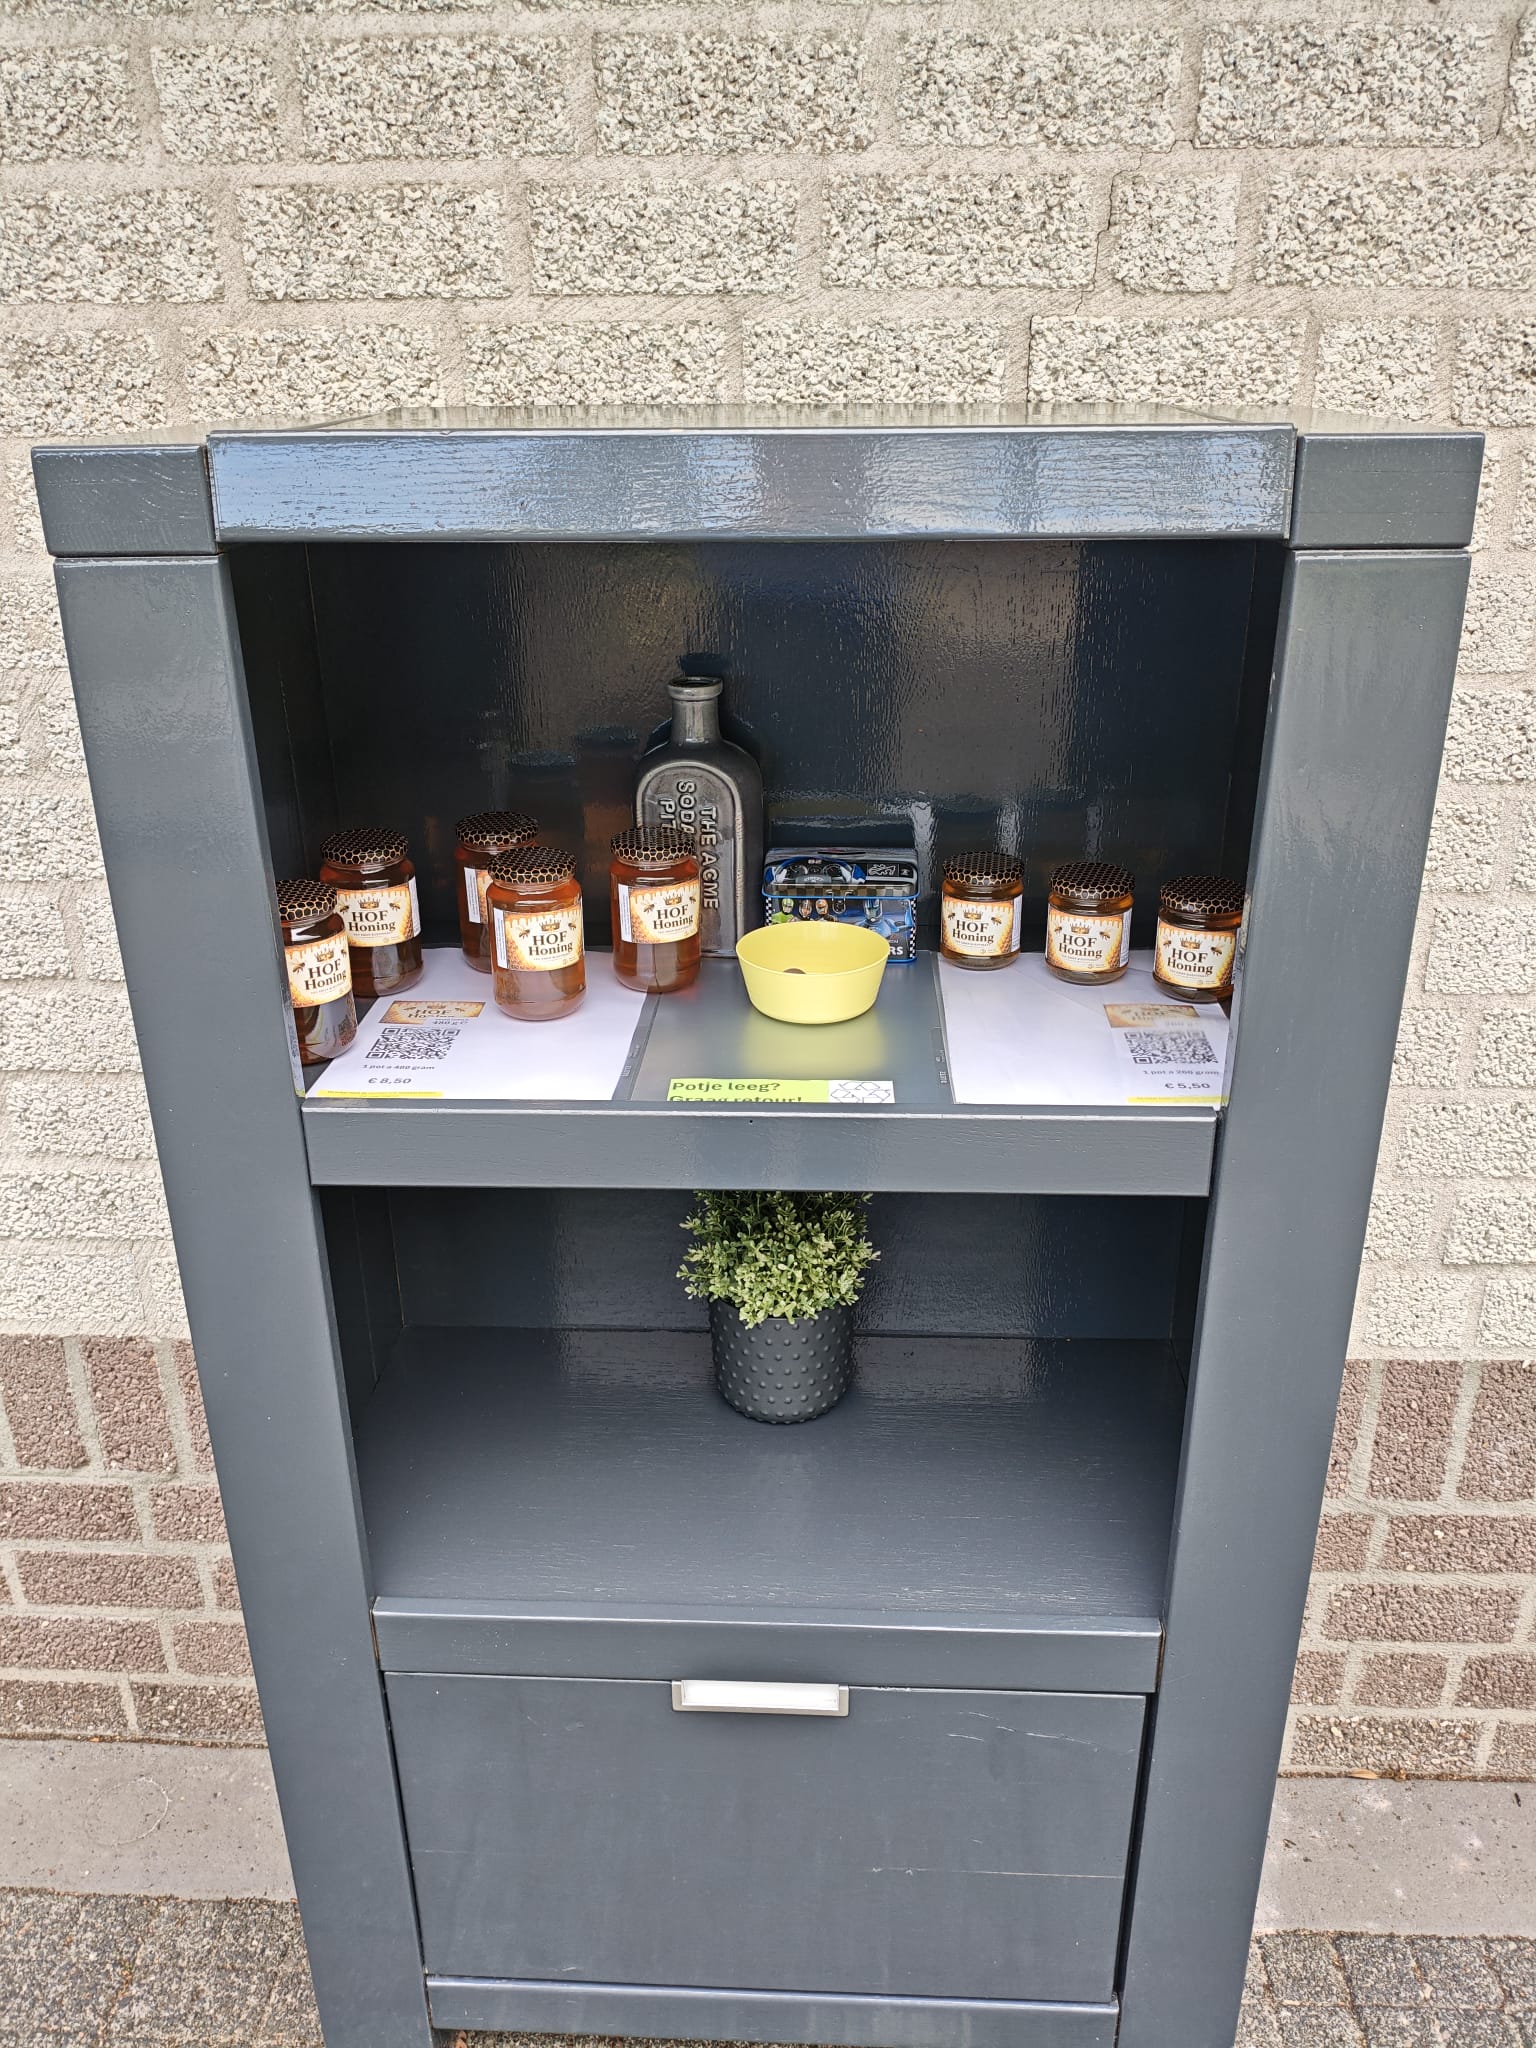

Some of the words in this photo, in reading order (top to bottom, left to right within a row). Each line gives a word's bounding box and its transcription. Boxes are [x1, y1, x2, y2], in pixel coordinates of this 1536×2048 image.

[700, 806, 717, 845] THE
[702, 852, 720, 910] ACME
[351, 910, 389, 923] HOF
[657, 904, 689, 919] HOF
[348, 921, 396, 933] Honing
[653, 915, 694, 930] Honing
[956, 920, 989, 933] HOF
[532, 930, 568, 946] HOF
[952, 928, 994, 944] Honing
[1063, 933, 1097, 948] HOF
[528, 941, 573, 957] Honing
[1058, 943, 1103, 959] Honing
[1171, 948, 1209, 963] HOF
[308, 958, 341, 979] HOF
[1167, 956, 1214, 975] Honing
[304, 969, 347, 991] Honing
[379, 1077, 412, 1085] 8,50
[672, 1082, 723, 1092] Potje
[728, 1082, 781, 1092] leeg?
[1177, 1082, 1211, 1090] 5,50
